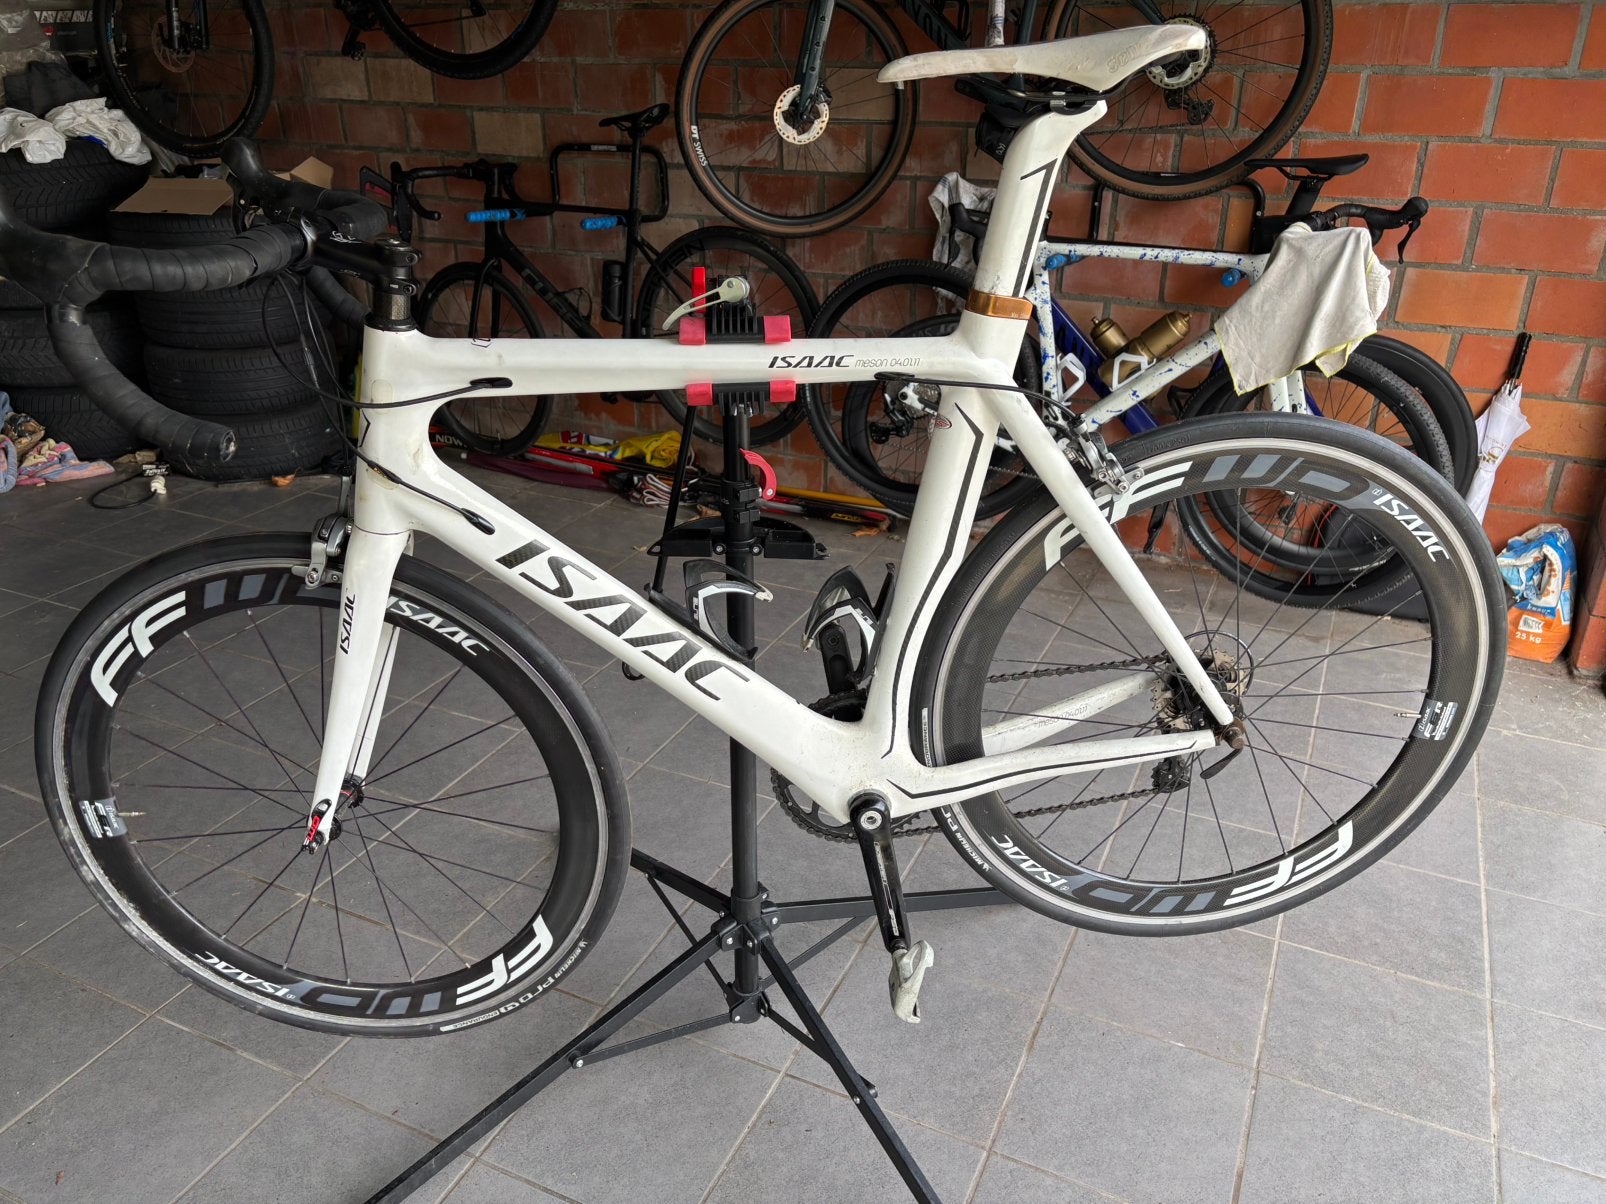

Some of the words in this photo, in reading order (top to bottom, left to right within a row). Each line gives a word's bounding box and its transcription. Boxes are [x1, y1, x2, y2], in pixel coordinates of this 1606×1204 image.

[768, 354, 855, 369] ISAAC
[854, 357, 888, 369] meson
[1373, 493, 1450, 563] ISAAC
[339, 593, 356, 655] ISAAC
[386, 595, 490, 656] ISAAC
[495, 539, 751, 701] ISAAC
[1515, 631, 1527, 641] 25
[1529, 633, 1543, 644] kg
[955, 832, 985, 867] MICHELIN
[991, 834, 1066, 889] ISAAC
[195, 950, 288, 998] ISAAC
[555, 948, 582, 979] MICHELIN
